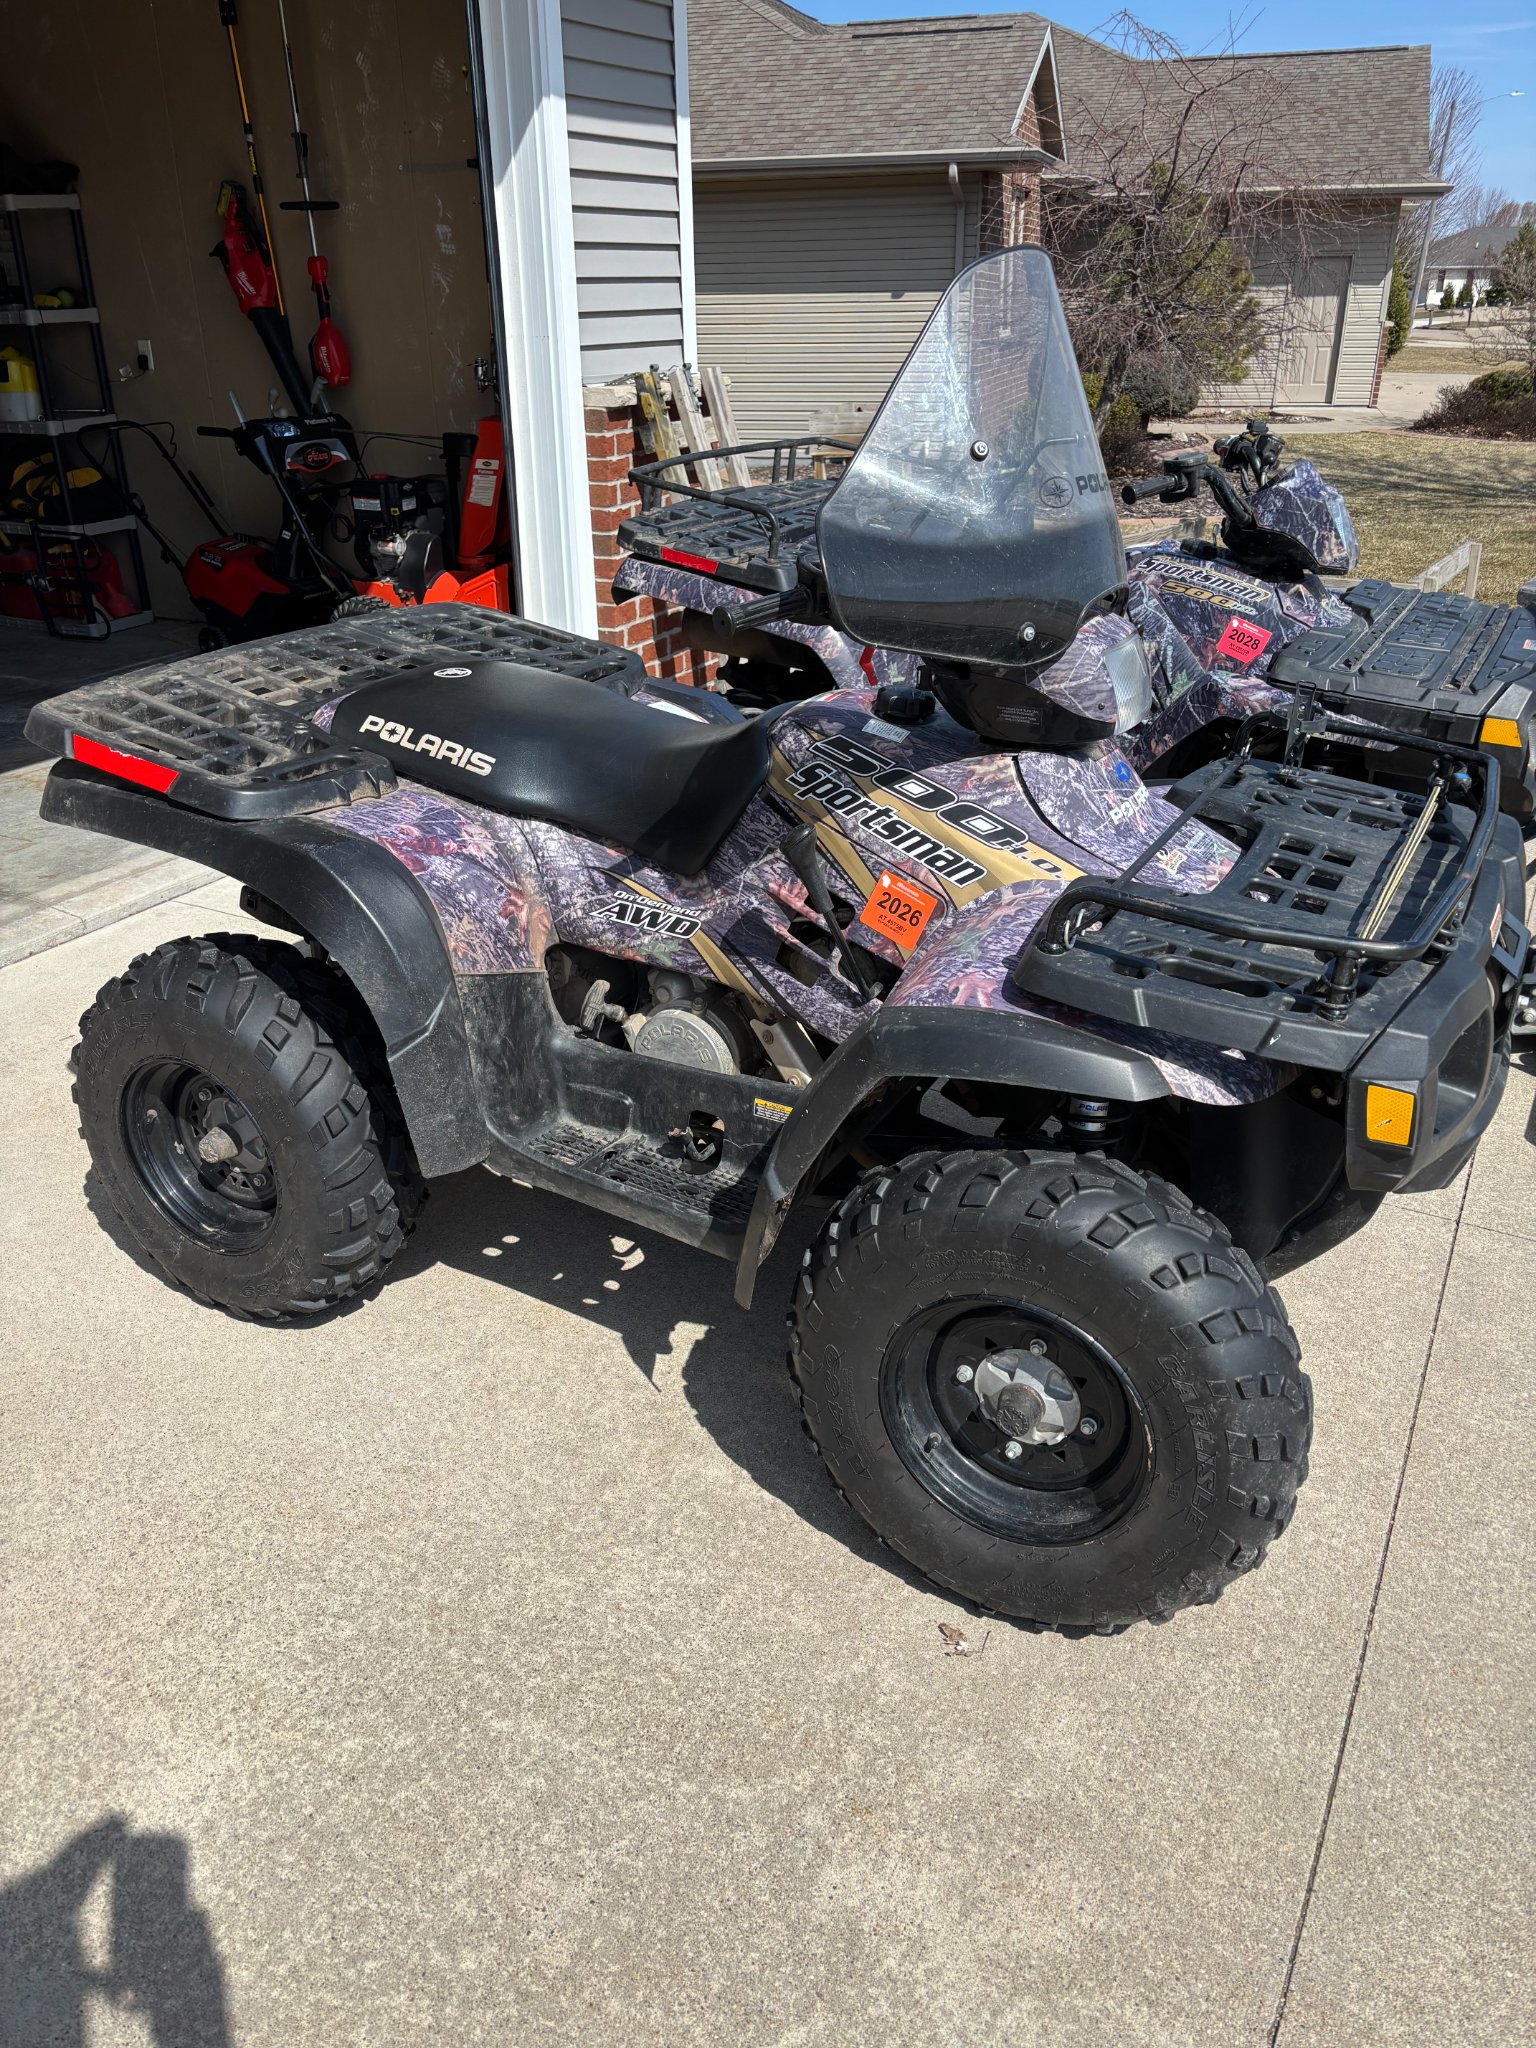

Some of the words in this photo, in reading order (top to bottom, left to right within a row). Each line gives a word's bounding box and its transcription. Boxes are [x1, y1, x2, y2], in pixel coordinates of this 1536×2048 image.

[1136, 557, 1264, 602] Sportsman
[1159, 580, 1239, 609] 500
[1228, 629, 1261, 650] 2028
[359, 714, 496, 777] POLARIS
[809, 734, 1029, 850] 500
[785, 761, 987, 888] Sportsman
[590, 899, 702, 939] AWD
[877, 892, 922, 927] 2026
[641, 1023, 713, 1064] POLARIS
[1157, 1354, 1217, 1534] CARLISLE
